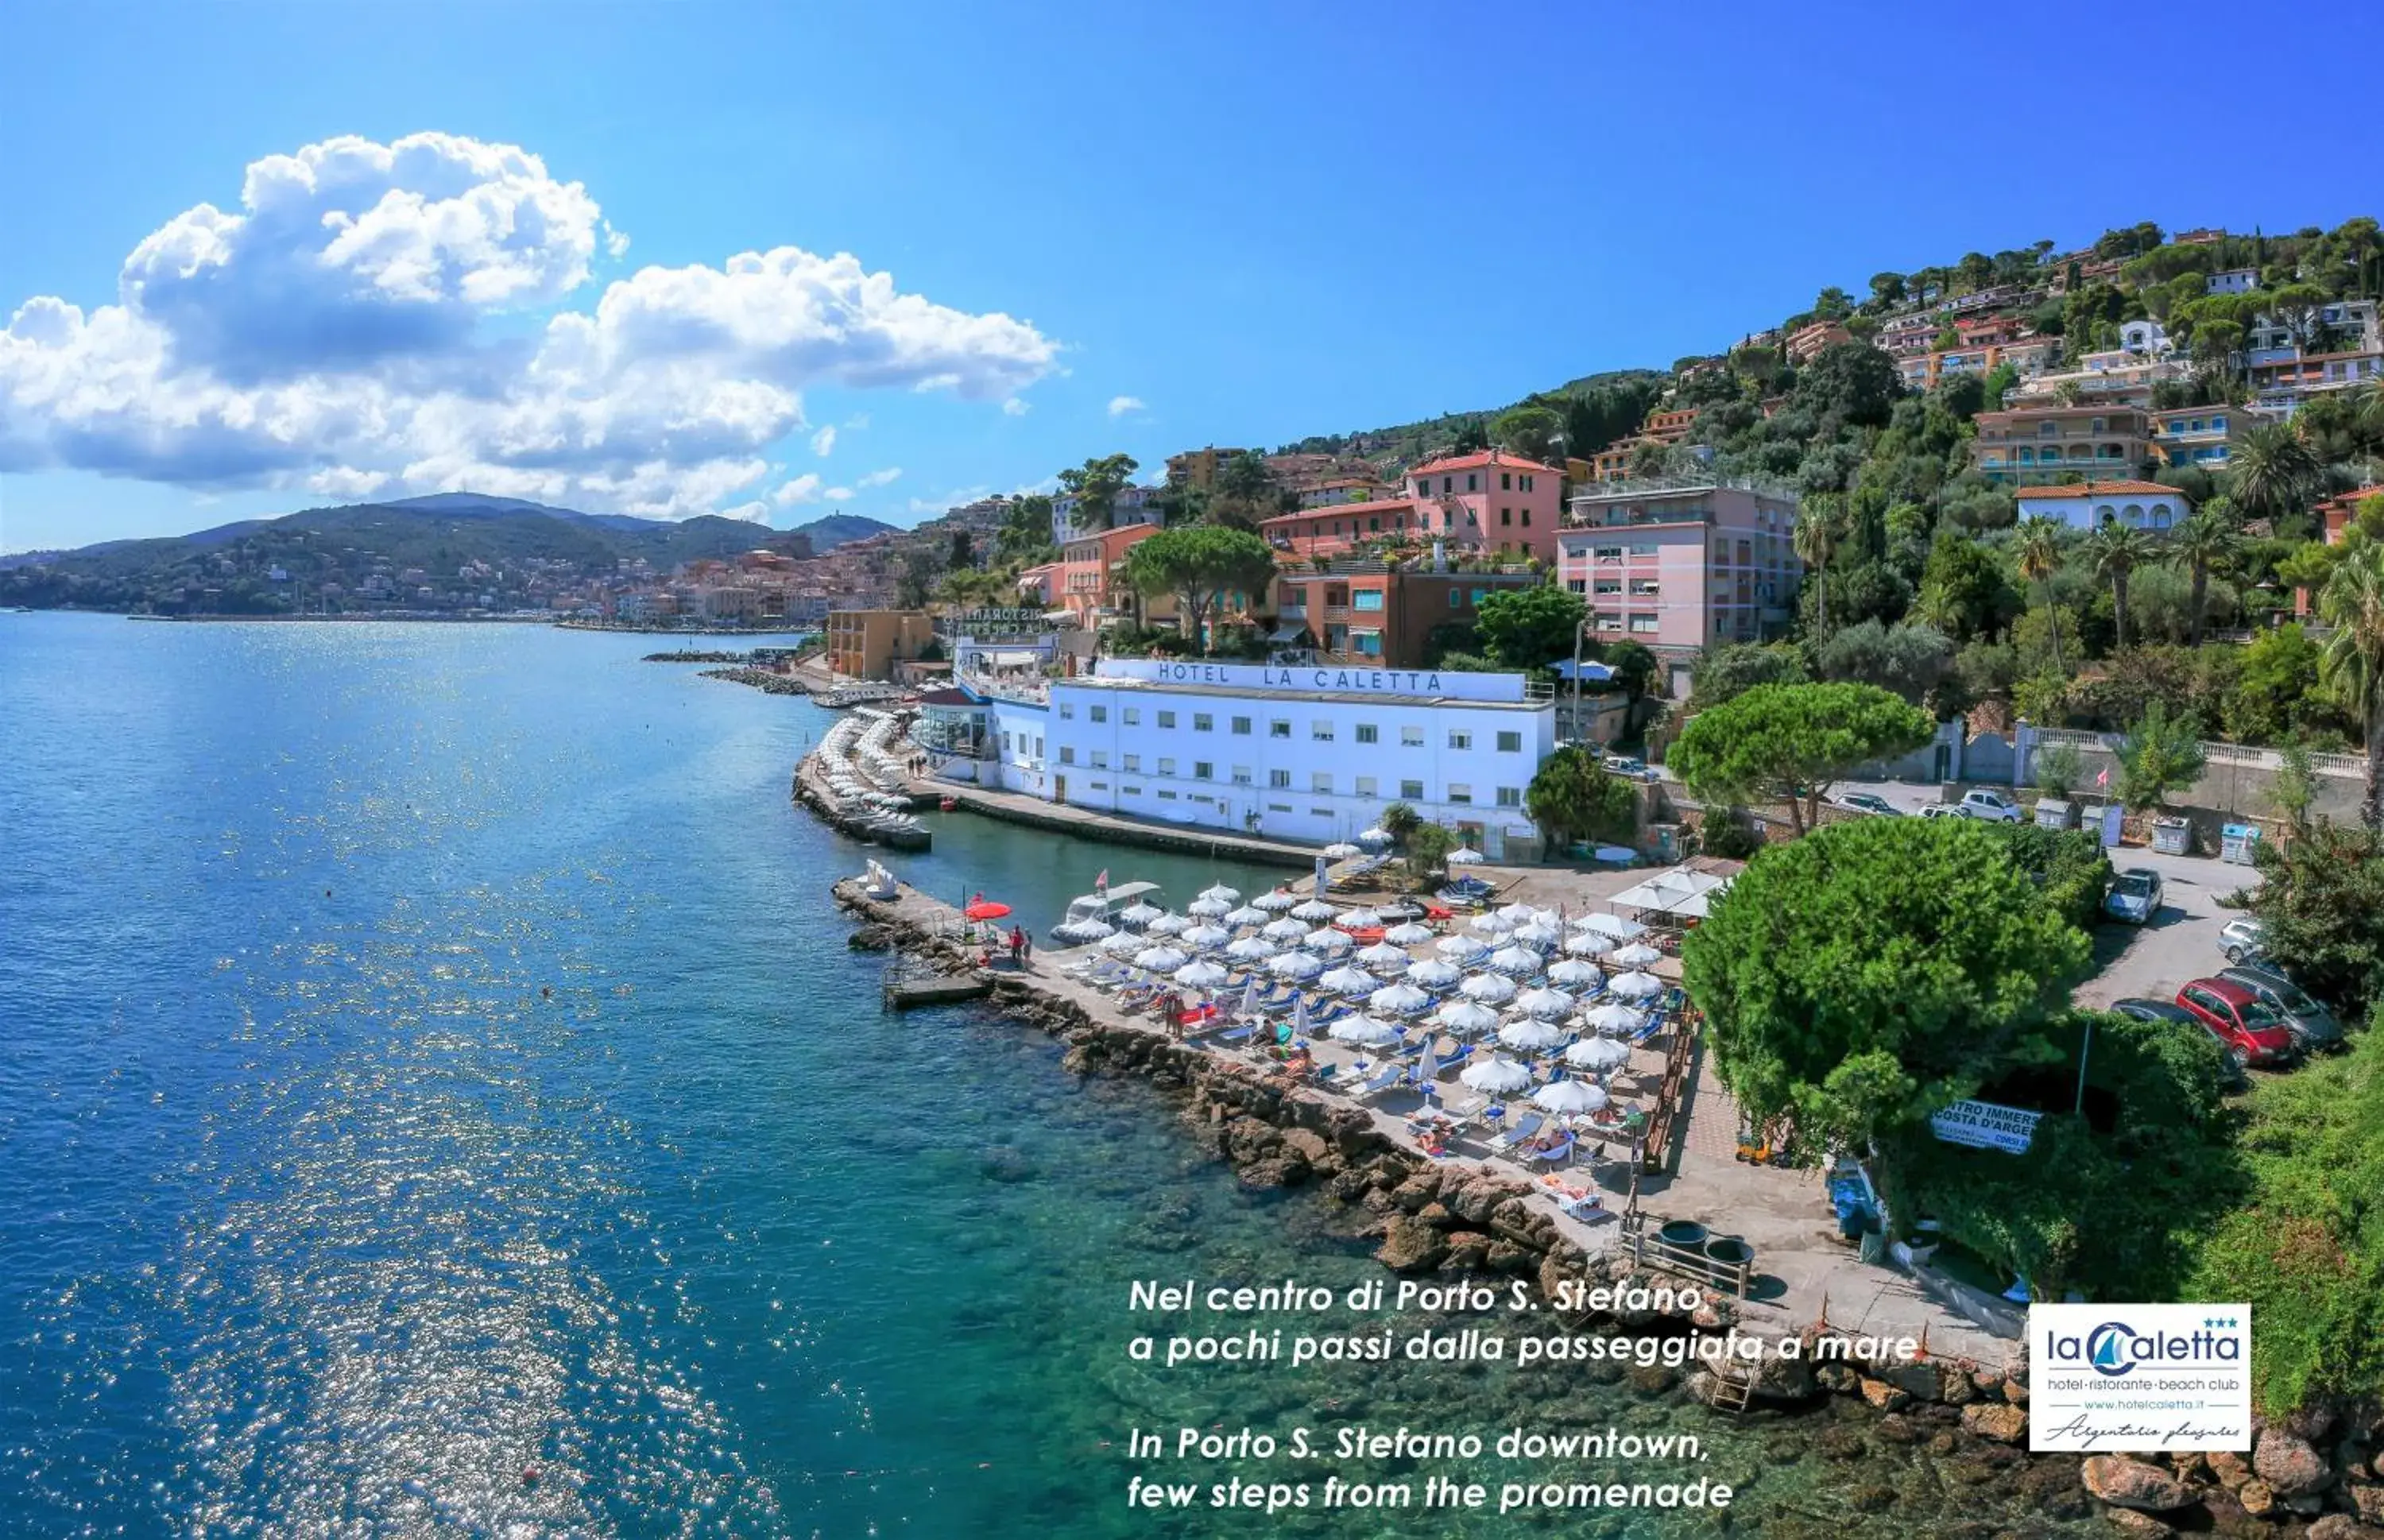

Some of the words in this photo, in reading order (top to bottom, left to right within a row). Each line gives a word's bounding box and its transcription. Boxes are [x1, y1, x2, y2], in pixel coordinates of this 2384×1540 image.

[1159, 664, 1229, 682] HOTEL
[1264, 669, 1291, 686] LA
[1315, 671, 1441, 691] CALETTA
[1933, 1109, 1977, 1126] COSTA
[1981, 1118, 2035, 1137] D'ARGE
[1943, 1101, 1983, 1116] NTRO
[1987, 1108, 2040, 1127] IMMERS
